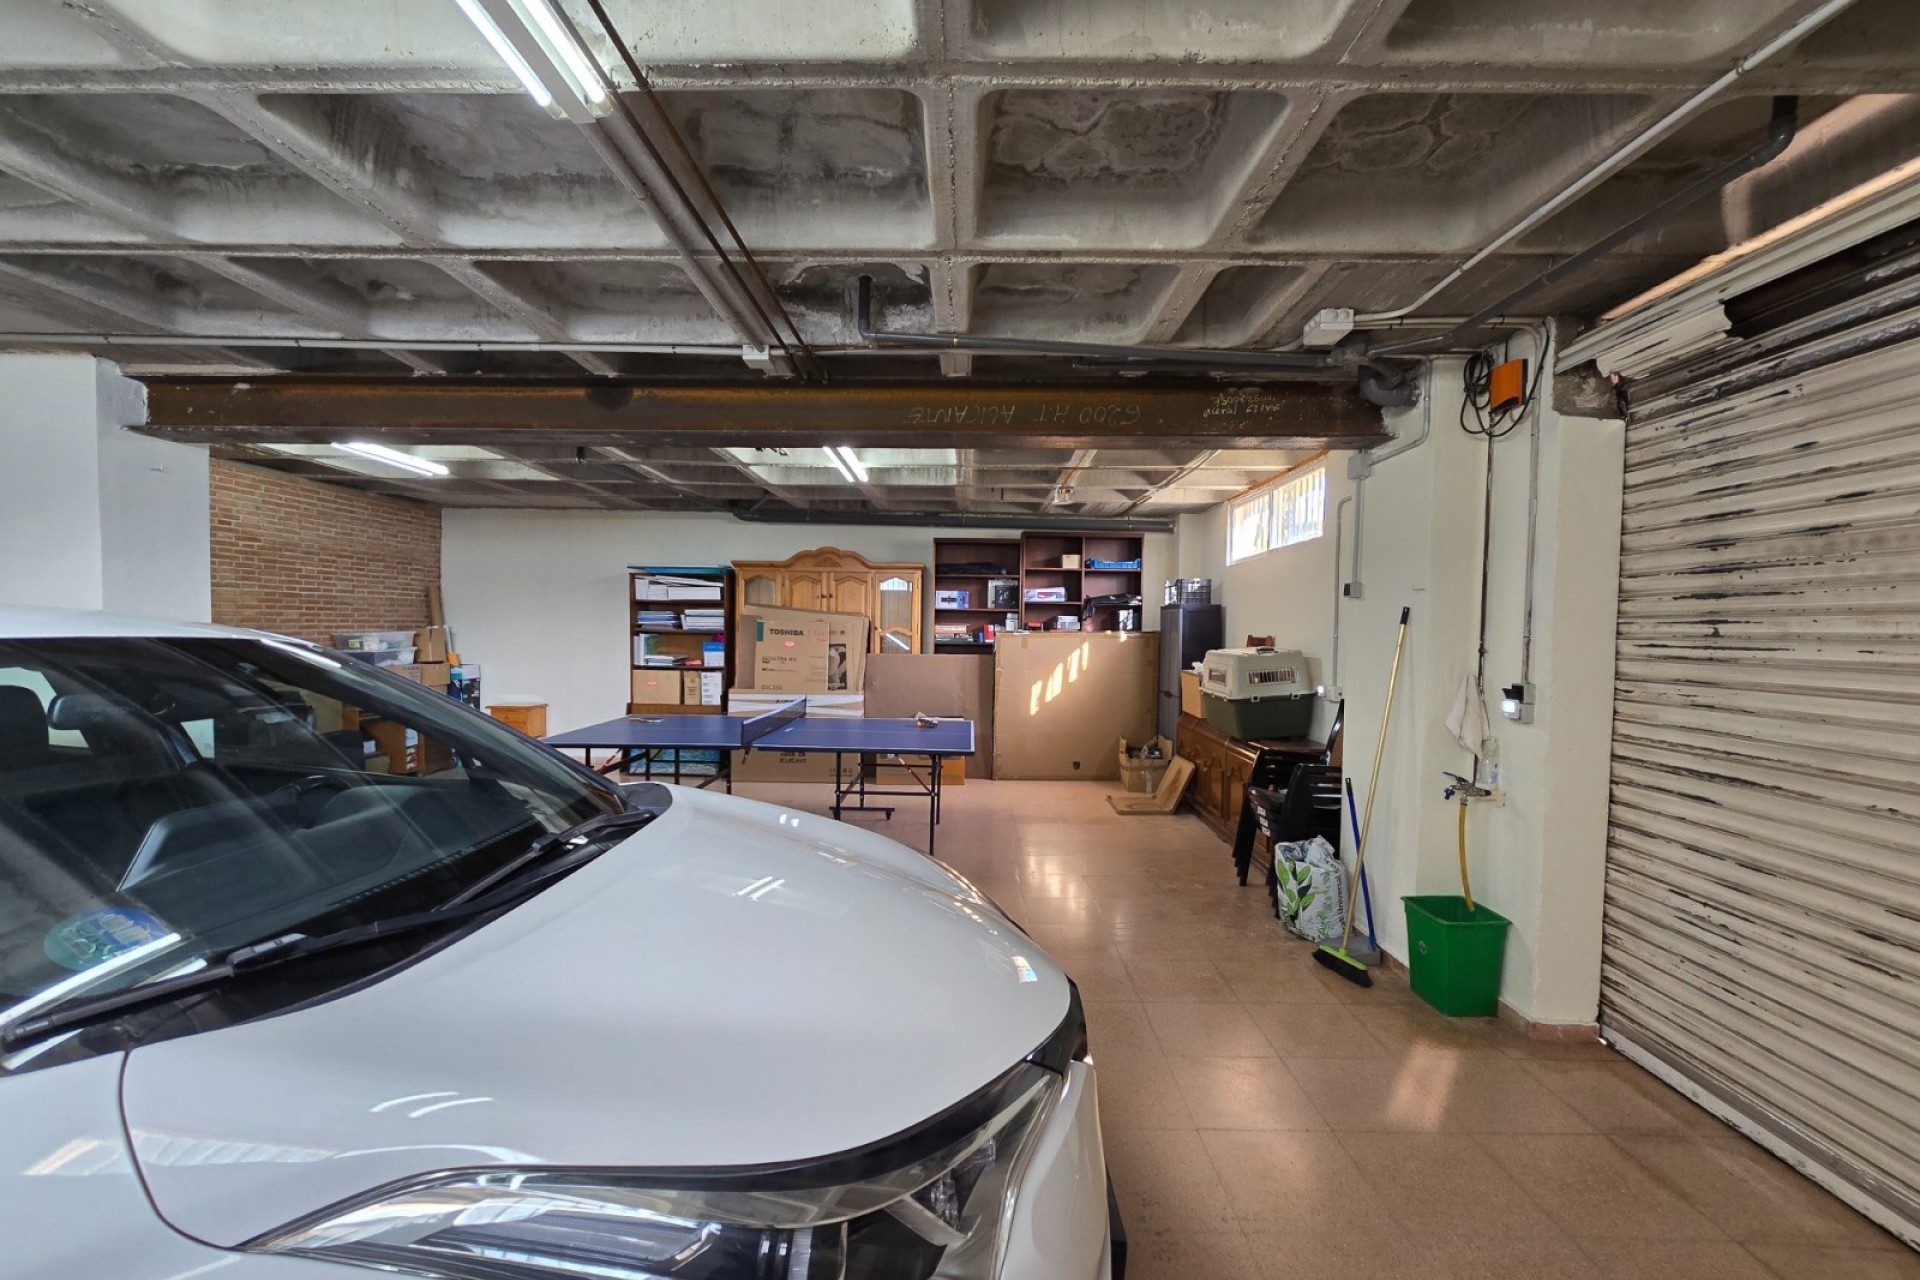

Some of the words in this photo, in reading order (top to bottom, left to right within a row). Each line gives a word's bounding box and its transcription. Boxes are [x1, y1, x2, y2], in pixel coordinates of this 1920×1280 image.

[903, 403, 1016, 426] ALICANTE
[769, 628, 804, 636] TOSHIBA
[1335, 874, 1344, 914] Universal
